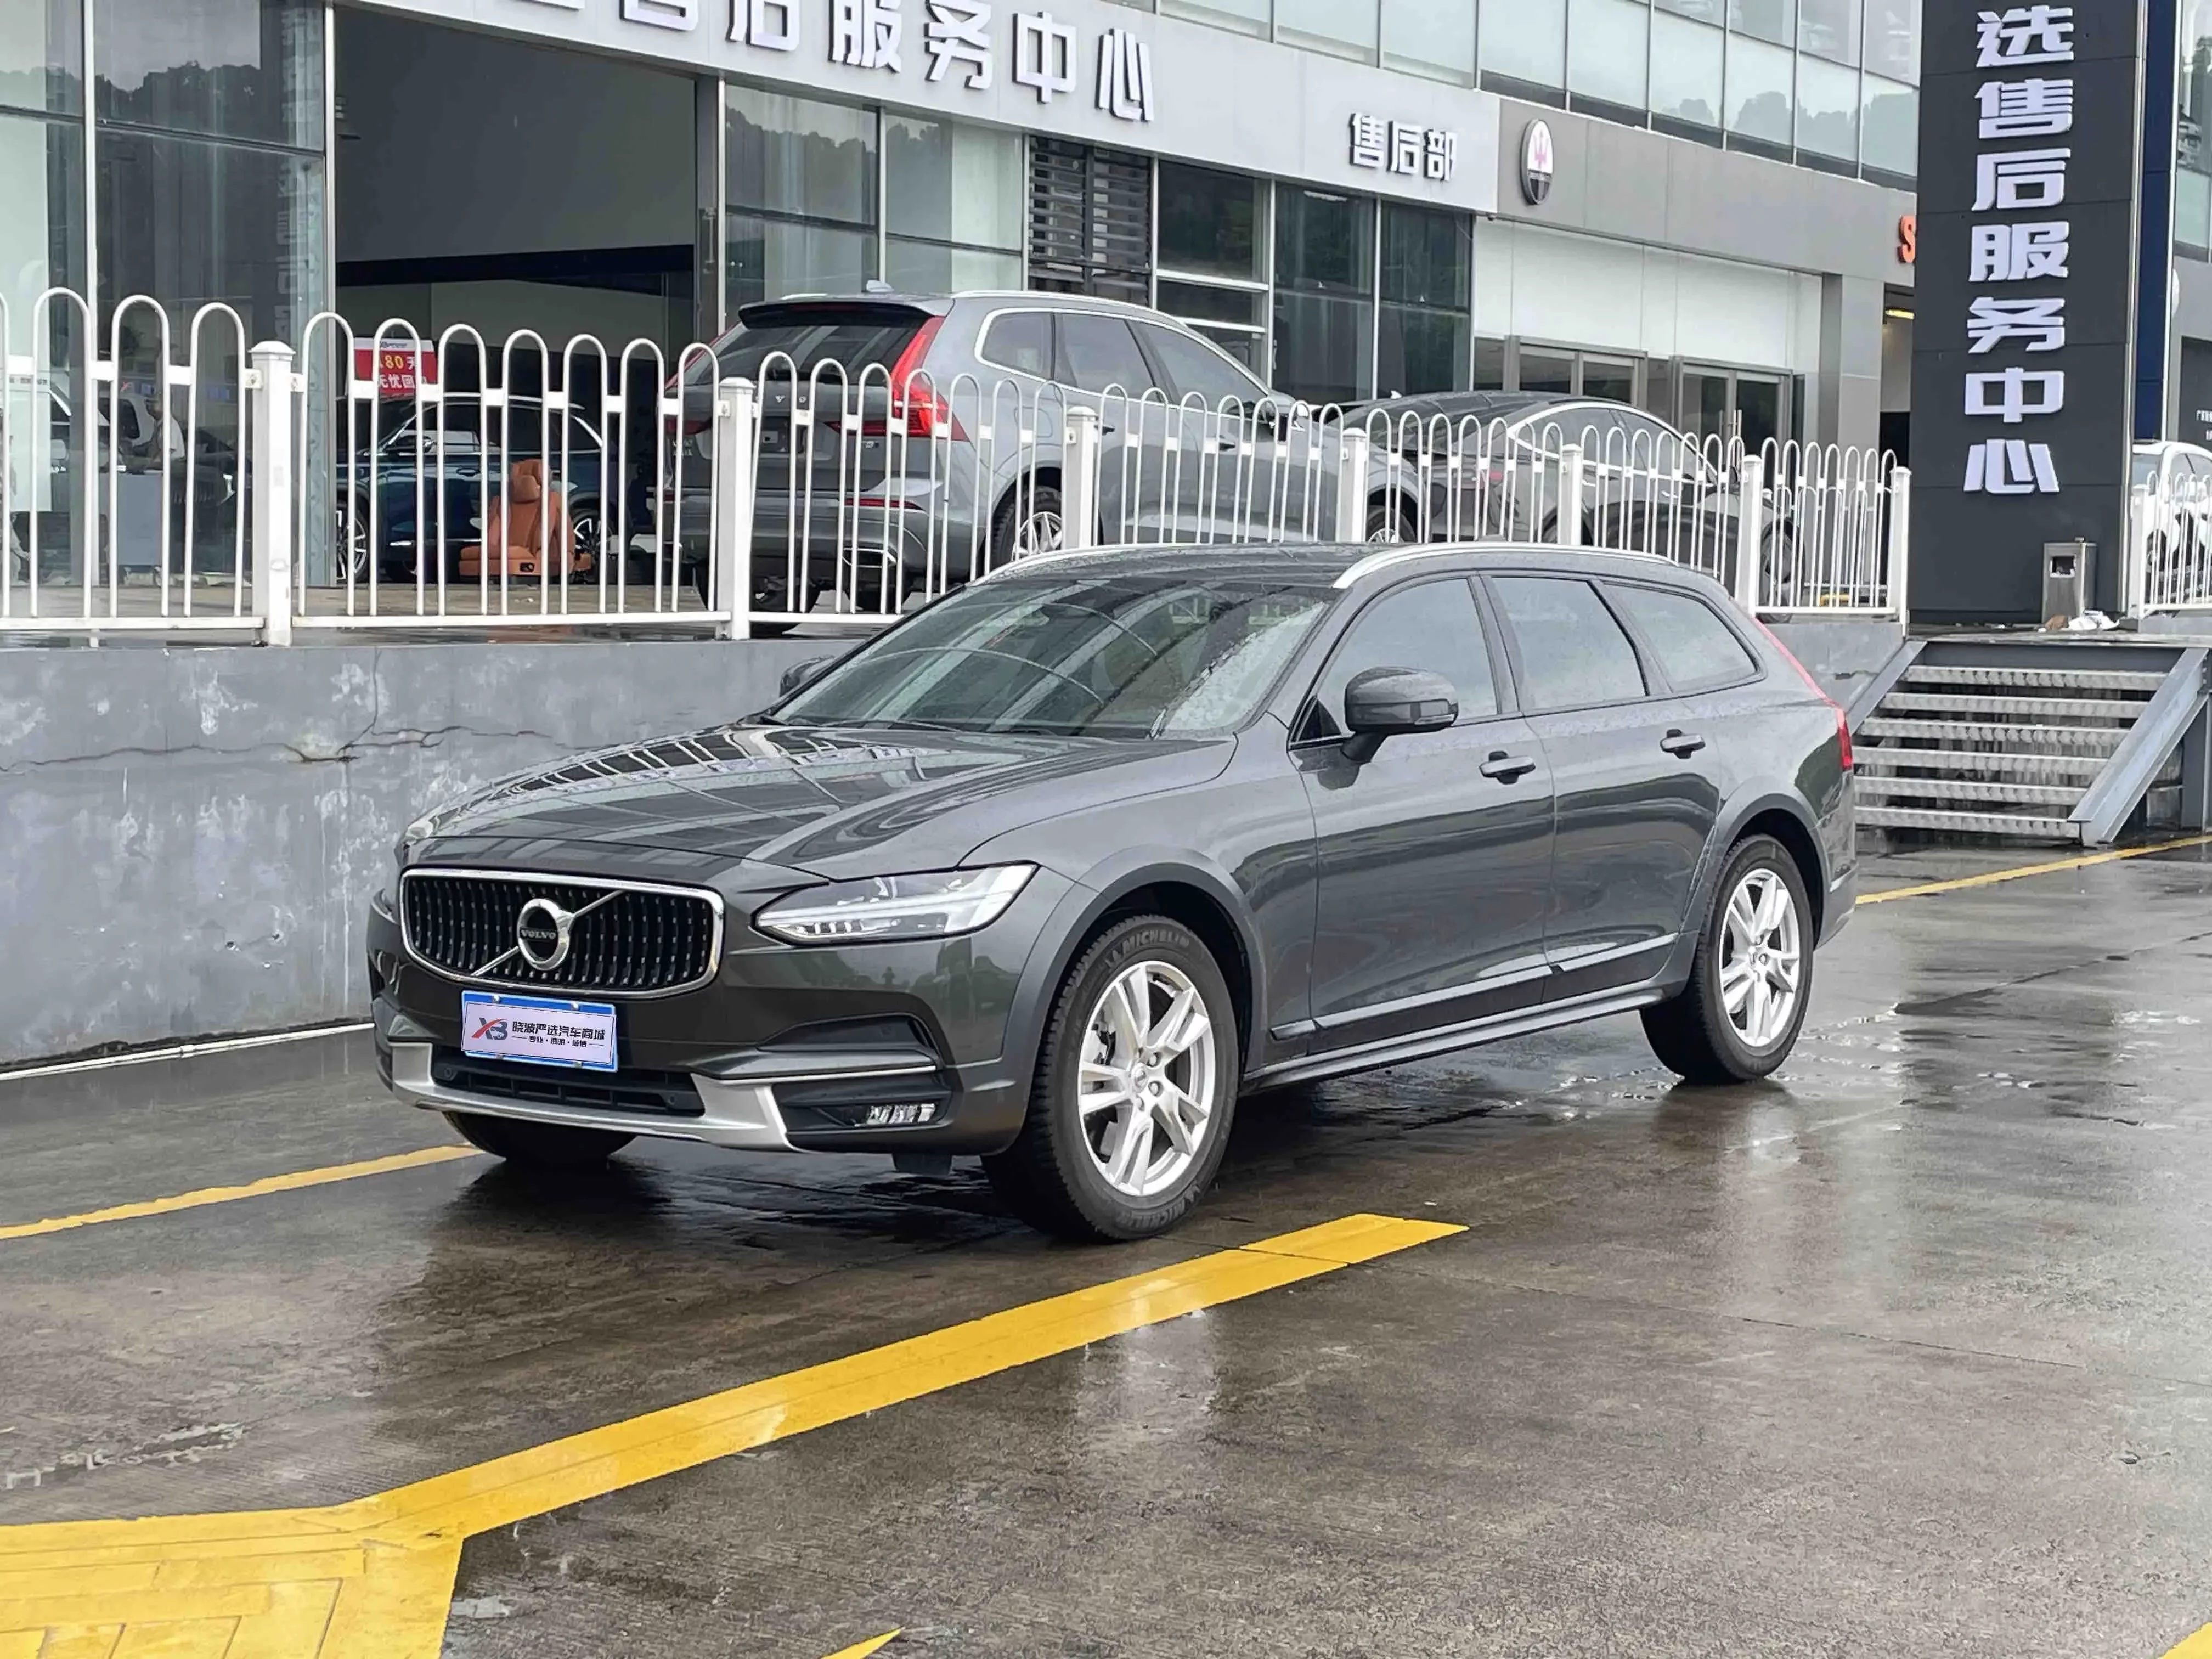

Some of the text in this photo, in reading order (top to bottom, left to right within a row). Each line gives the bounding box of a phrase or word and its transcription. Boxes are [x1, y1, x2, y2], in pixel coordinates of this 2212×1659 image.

[1350, 112, 1457, 182] 售后部
[1963, 4, 2075, 494] 选售后服务中心
[521, 929, 556, 940] VOLVO
[1122, 929, 1189, 955] MICHELIN
[512, 1021, 606, 1040] 晓波严选汽车商城
